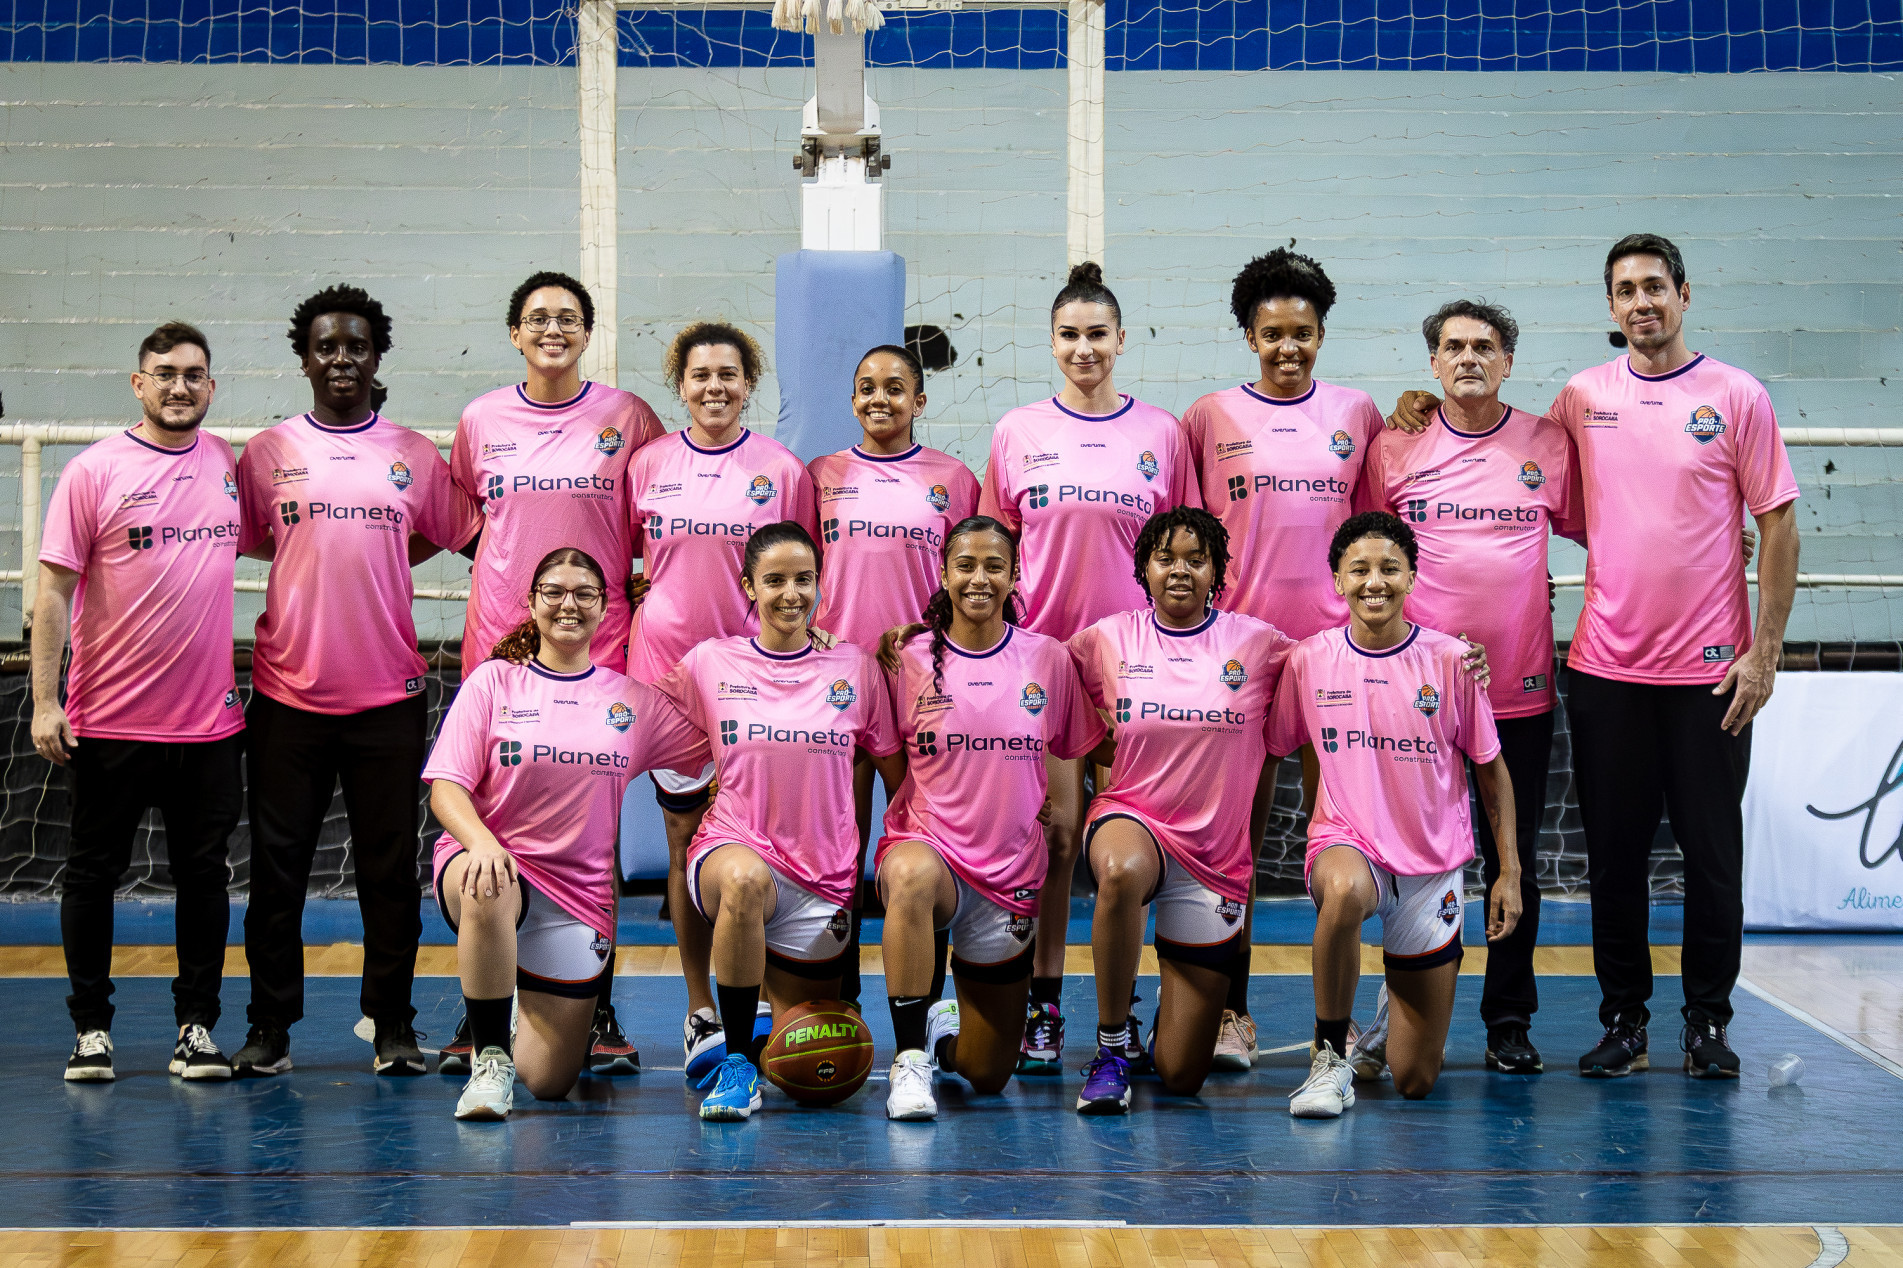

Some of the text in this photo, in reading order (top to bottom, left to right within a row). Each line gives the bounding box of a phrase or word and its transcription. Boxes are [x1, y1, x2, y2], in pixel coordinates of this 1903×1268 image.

[1685, 424, 1726, 433] ESPORTE
[1698, 417, 1718, 425] PRÓ-
[595, 440, 625, 450] ESPORTE
[514, 474, 614, 492] Planeta
[1254, 475, 1348, 494] Planeta
[1518, 475, 1546, 483] ESPORTE
[746, 490, 777, 498] ESPORTE
[1059, 485, 1151, 514] Planeta
[309, 502, 403, 524] Planeta
[1437, 502, 1538, 522] Planeta
[670, 518, 756, 536] Planet
[849, 520, 942, 546] Planeta
[1020, 699, 1048, 707] ESPORTE
[606, 716, 636, 725] ESPORTE
[1140, 702, 1245, 724] Planeta
[748, 724, 849, 747] Planeta
[946, 734, 1043, 752] Planeta
[1346, 730, 1438, 754] Planeta
[533, 745, 629, 768] Planeta
[785, 1023, 858, 1048] PENALTY
